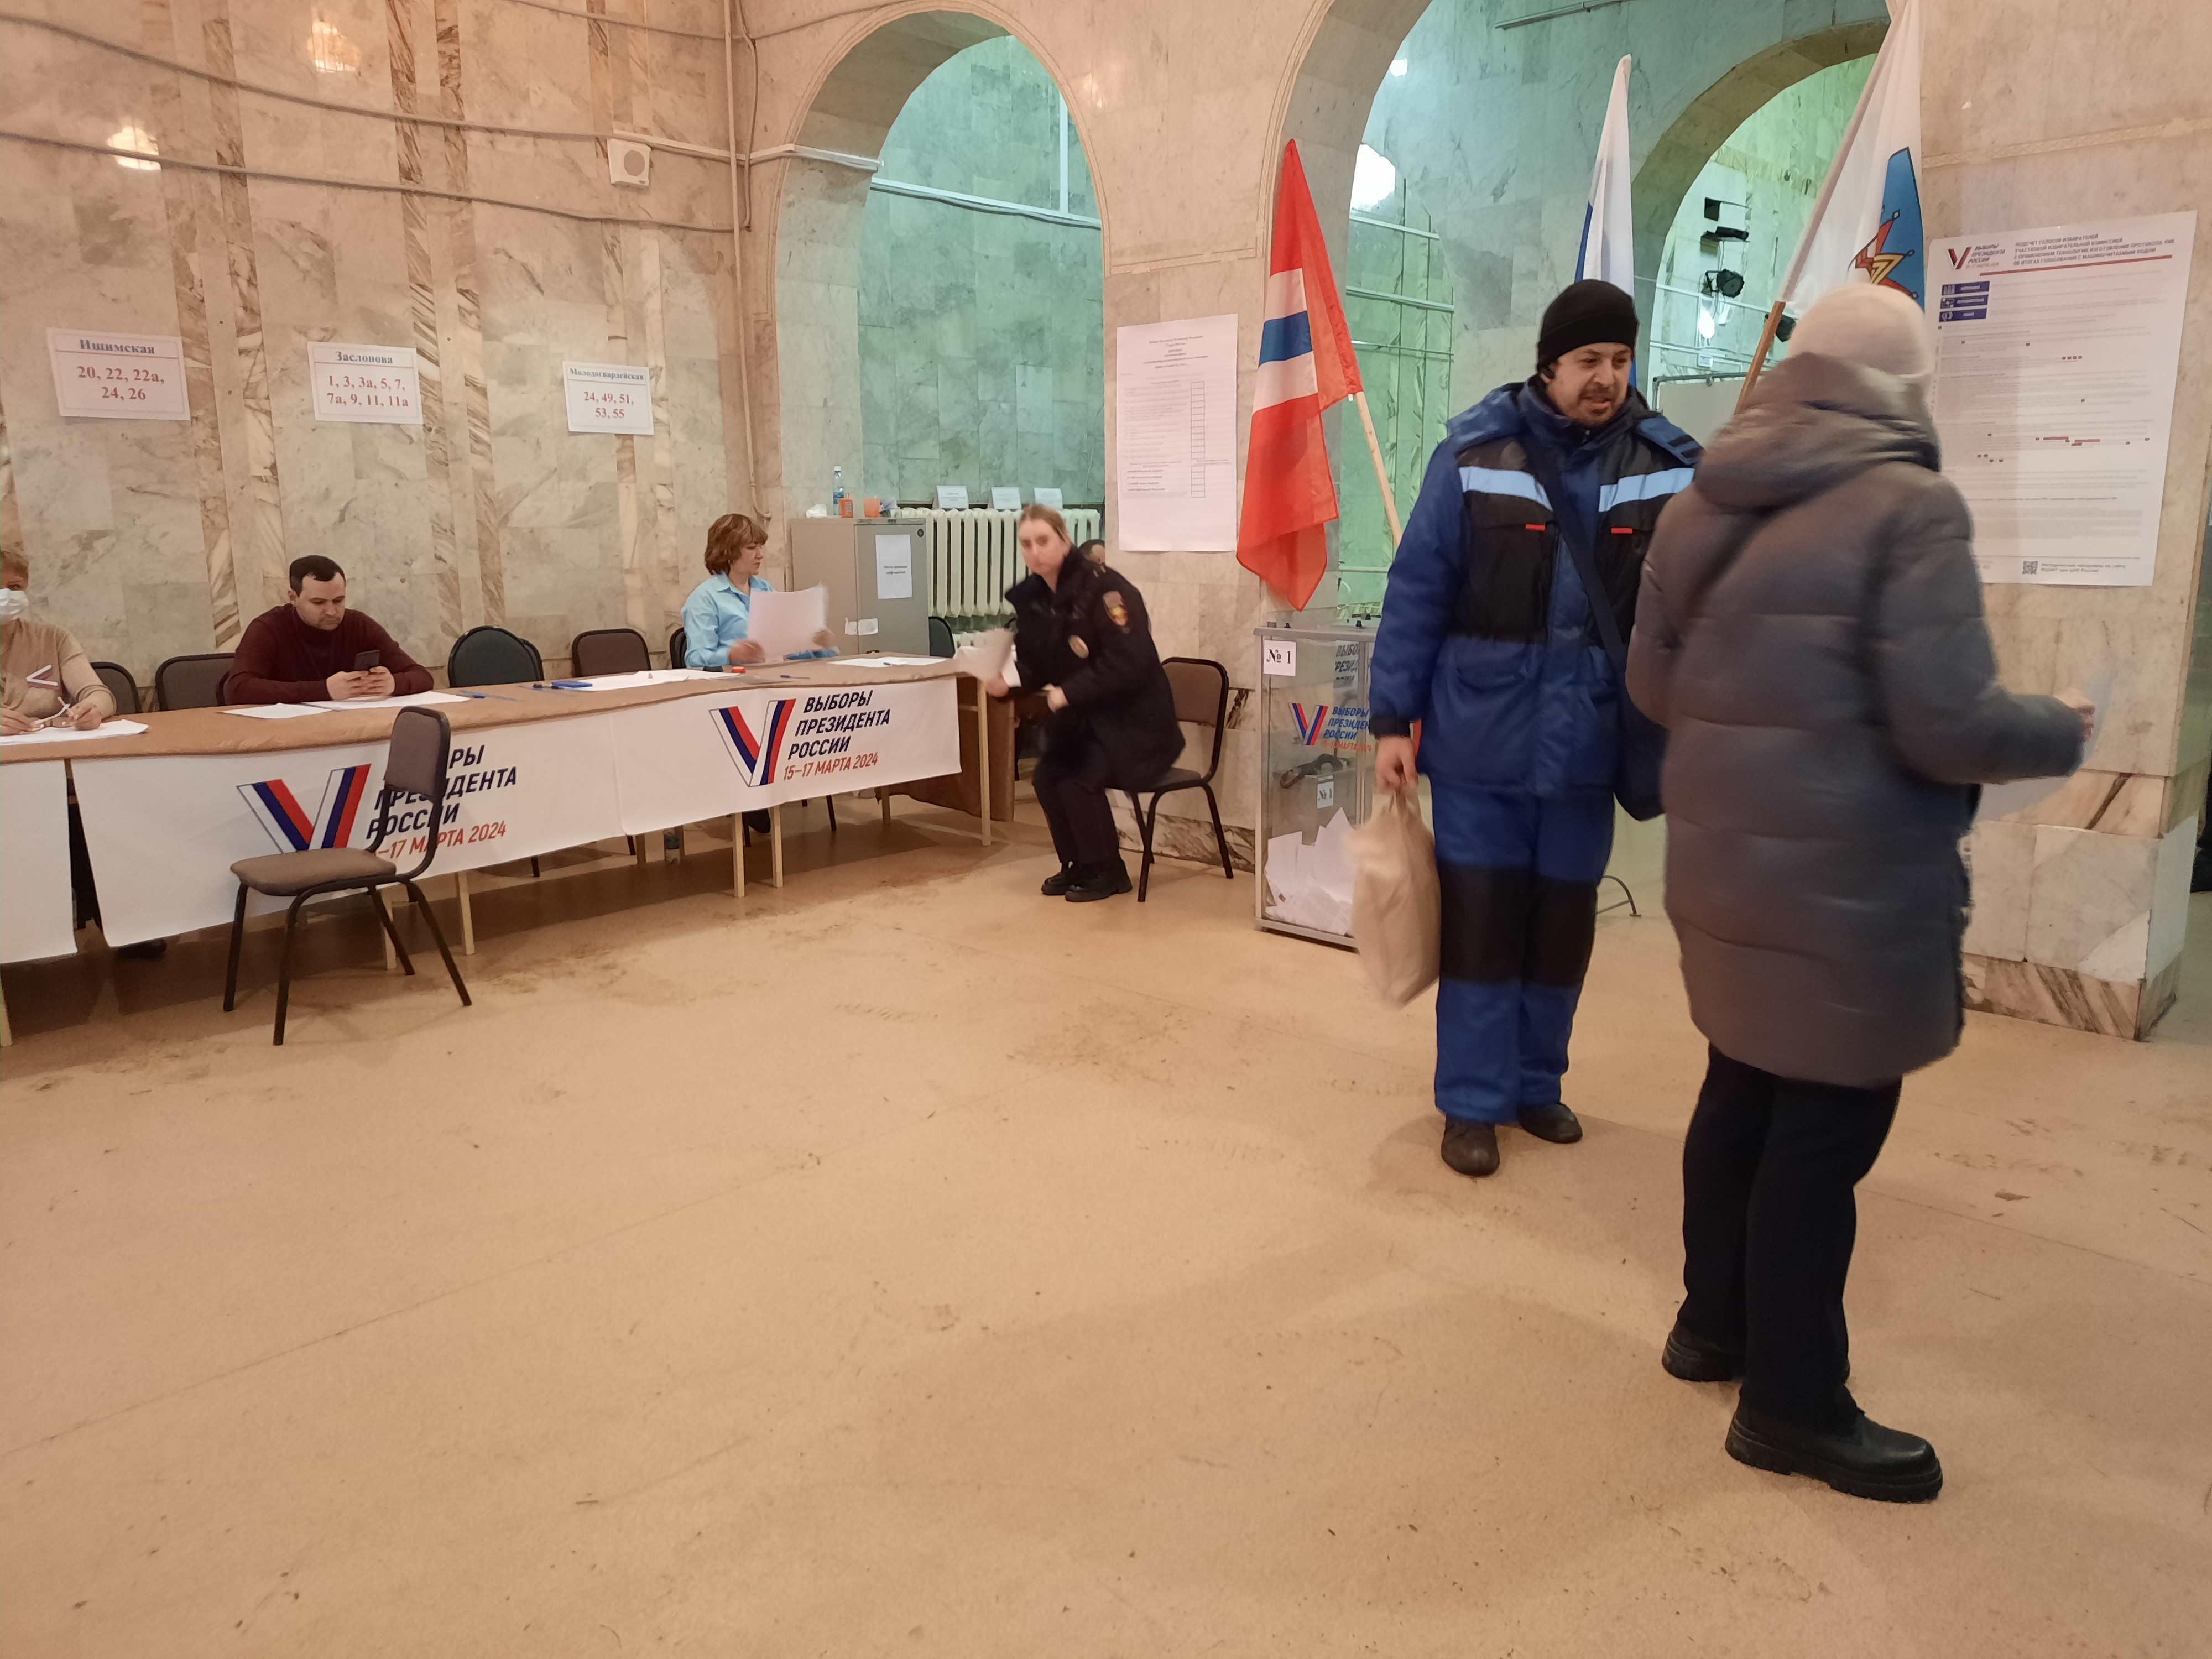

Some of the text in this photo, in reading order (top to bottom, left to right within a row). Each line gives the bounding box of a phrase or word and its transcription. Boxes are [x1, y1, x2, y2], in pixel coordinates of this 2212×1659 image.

[79, 338, 155, 354] Ишимская
[336, 351, 393, 364] Заслонова
[77, 365, 165, 384] 20, 22, 22а,
[570, 367, 644, 380] Молодогвардейская
[328, 375, 405, 392] 1, 3, 3а, 5, 7,
[101, 386, 147, 401] 24, 26
[327, 393, 409, 408] 7а, 9, 11, 11а
[583, 391, 635, 406] 24, 49, 51,
[595, 407, 625, 419] 53, 55
[1266, 649, 1292, 664] № 1
[803, 690, 874, 713] ВЫБОРЫ
[1332, 706, 1370, 718] ВЫБОРЫ
[795, 708, 891, 737] ПРЕЗИДЕНТА
[1328, 718, 1370, 730] ПРЕЗИДЕН
[1323, 729, 1359, 740] РОССИИ
[787, 736, 852, 760] РОССИИ
[815, 755, 852, 775] МАРТА
[853, 752, 878, 768] 2024
[467, 820, 507, 844] 2024
